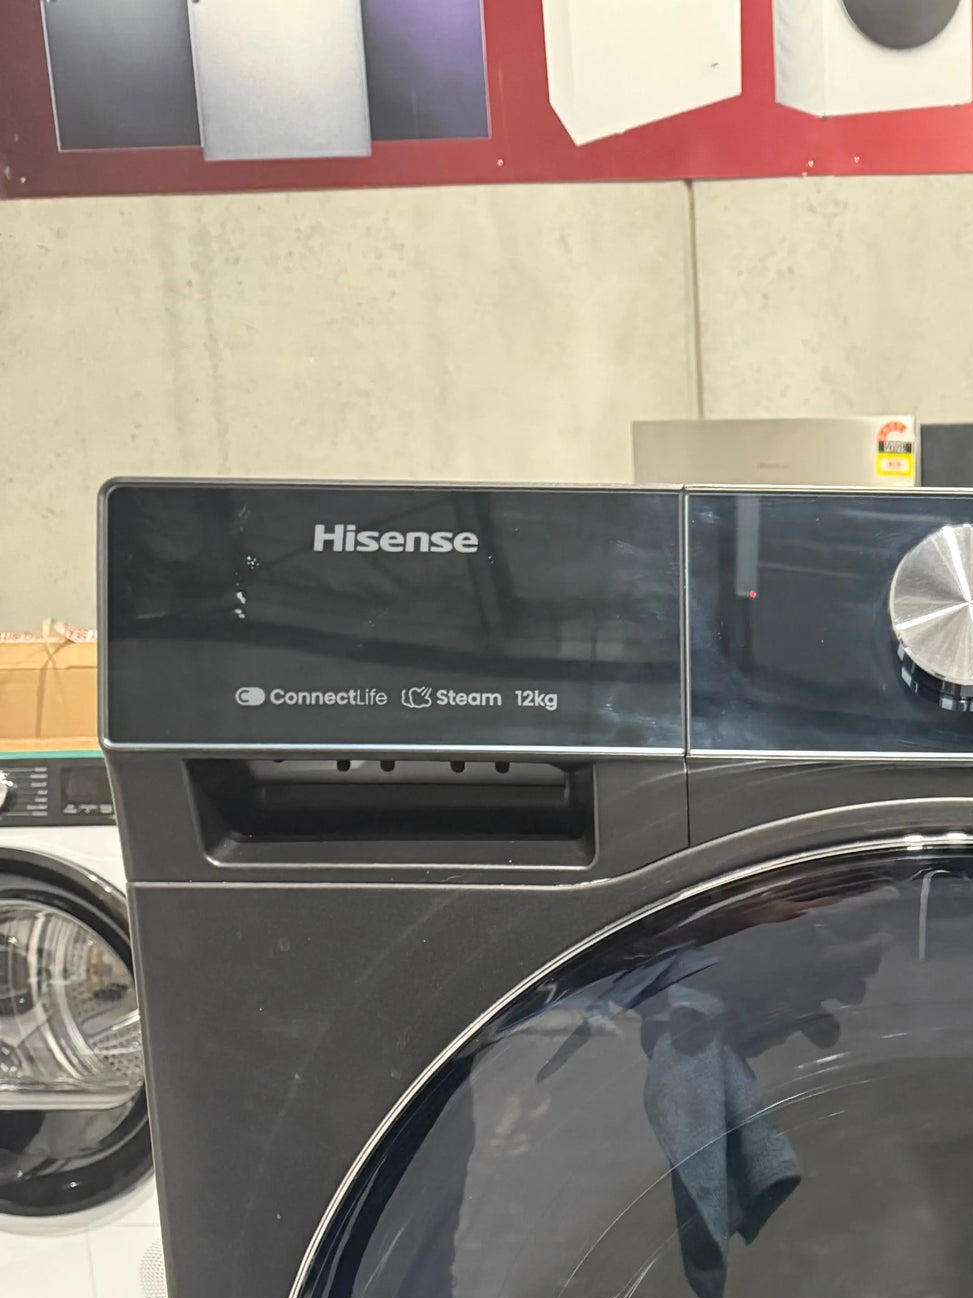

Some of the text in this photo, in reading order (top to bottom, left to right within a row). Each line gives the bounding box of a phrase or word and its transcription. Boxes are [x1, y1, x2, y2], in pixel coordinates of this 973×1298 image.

[313, 524, 479, 553] Hisense
[270, 689, 558, 711] ConnectLife Steam 12kg
